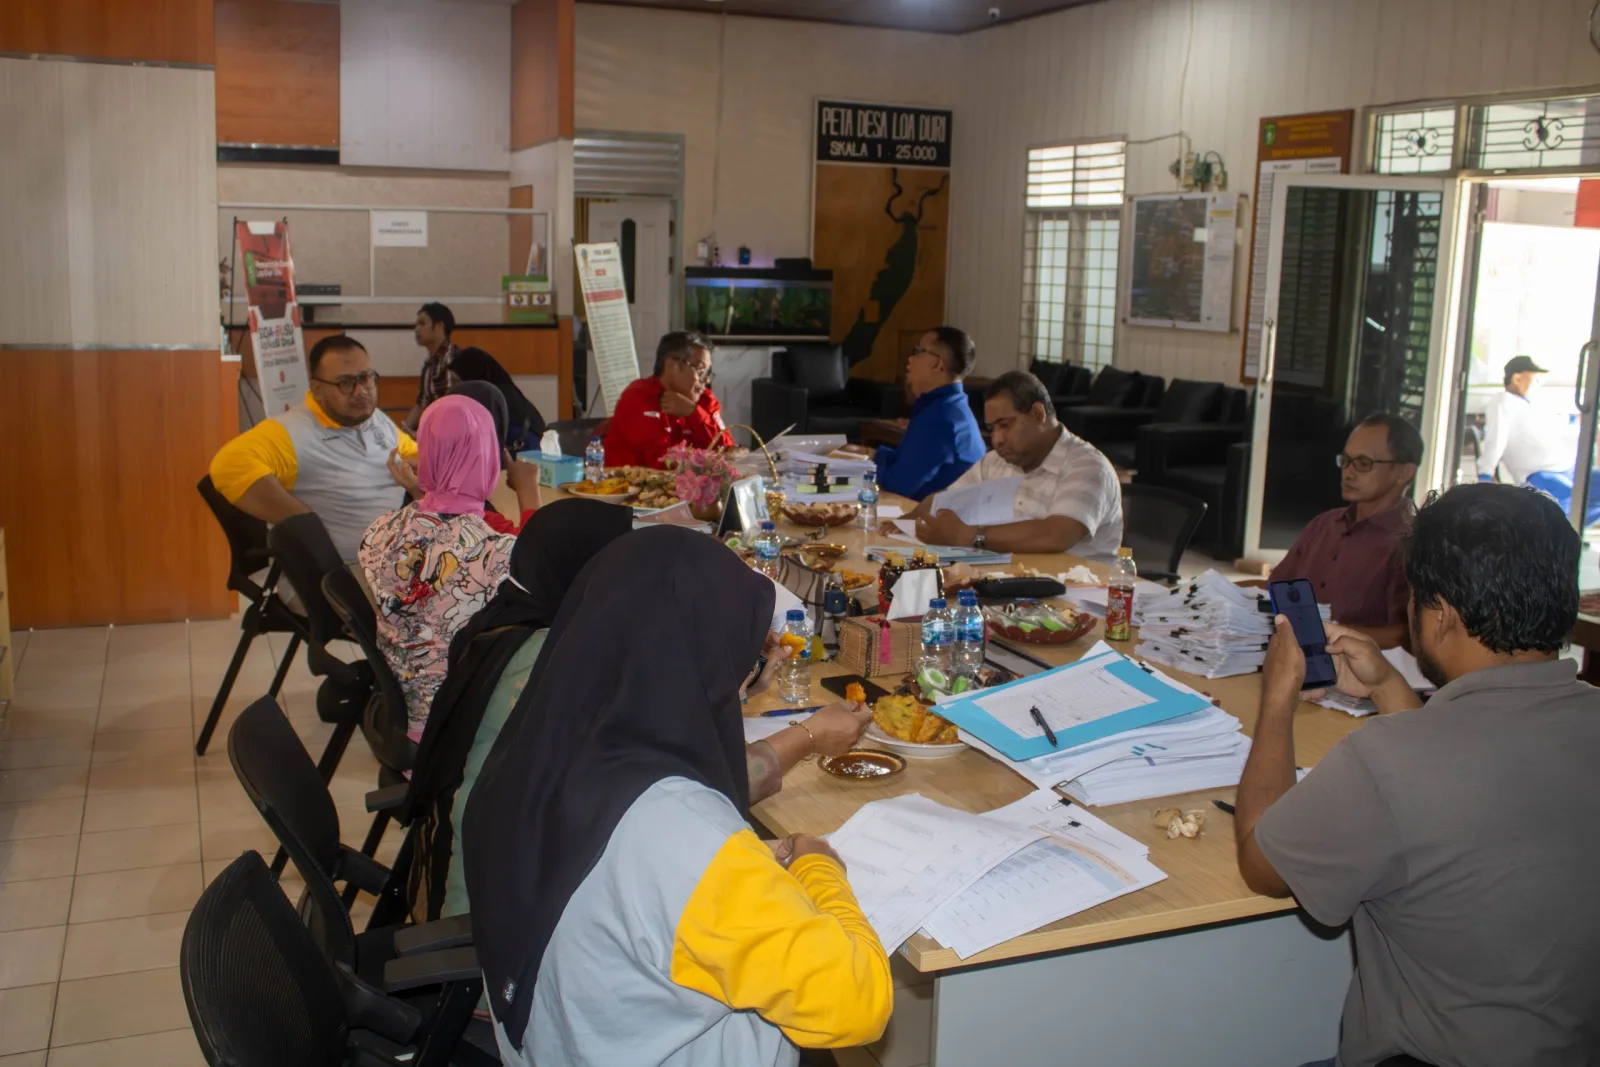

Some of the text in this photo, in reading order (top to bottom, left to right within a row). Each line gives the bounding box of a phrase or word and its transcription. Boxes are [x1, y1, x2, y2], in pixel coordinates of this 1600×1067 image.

[821, 107, 947, 143] PETA DESA LOA DURI
[829, 141, 868, 157] SKALA
[876, 143, 882, 158] 1
